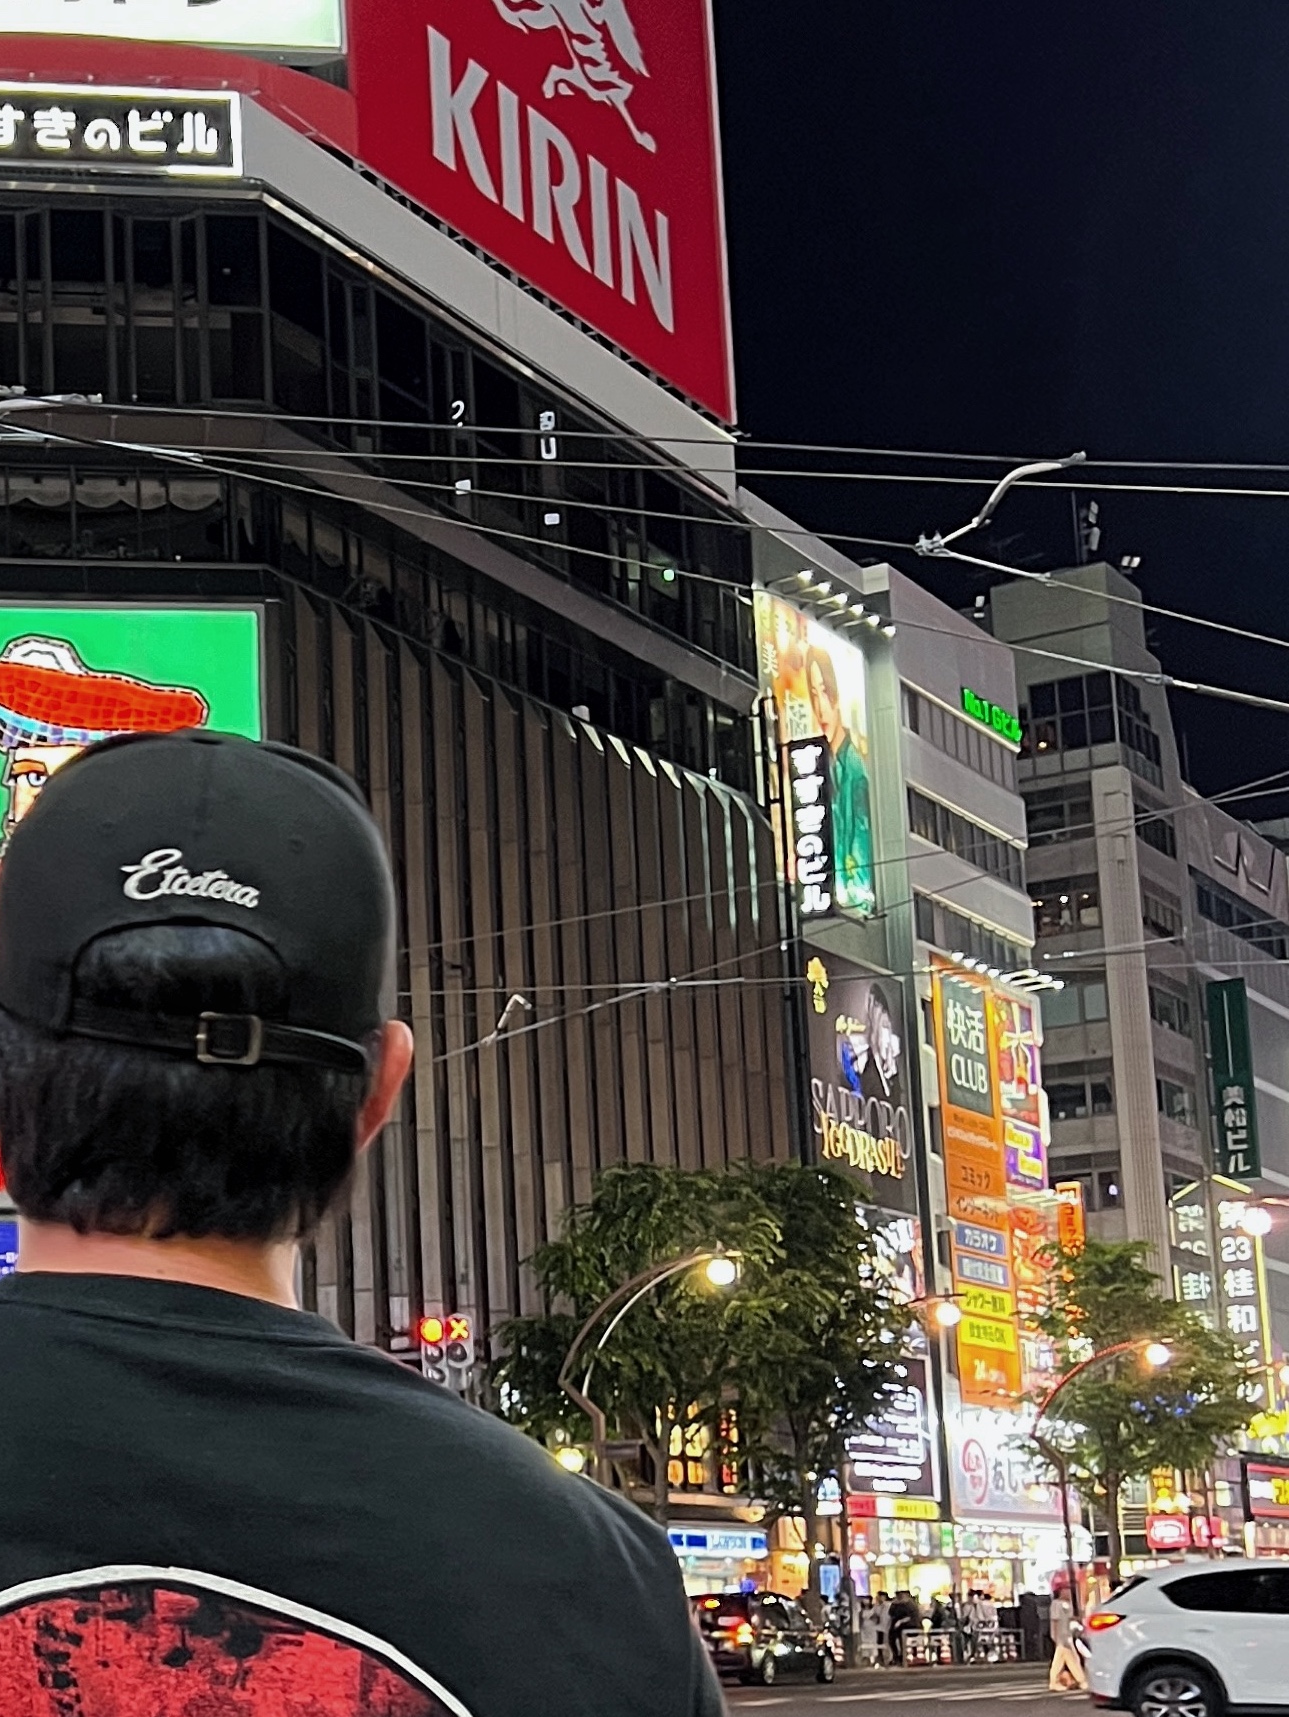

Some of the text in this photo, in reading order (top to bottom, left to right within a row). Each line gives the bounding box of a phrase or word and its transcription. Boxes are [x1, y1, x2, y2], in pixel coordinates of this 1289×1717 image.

[427, 24, 674, 334] KIRIN
[120, 848, 260, 908] Etcetera
[947, 998, 985, 1054] 快活
[951, 1053, 988, 1094] CLUB
[961, 1165, 990, 1189] コミック
[964, 1228, 997, 1252] カラオケ
